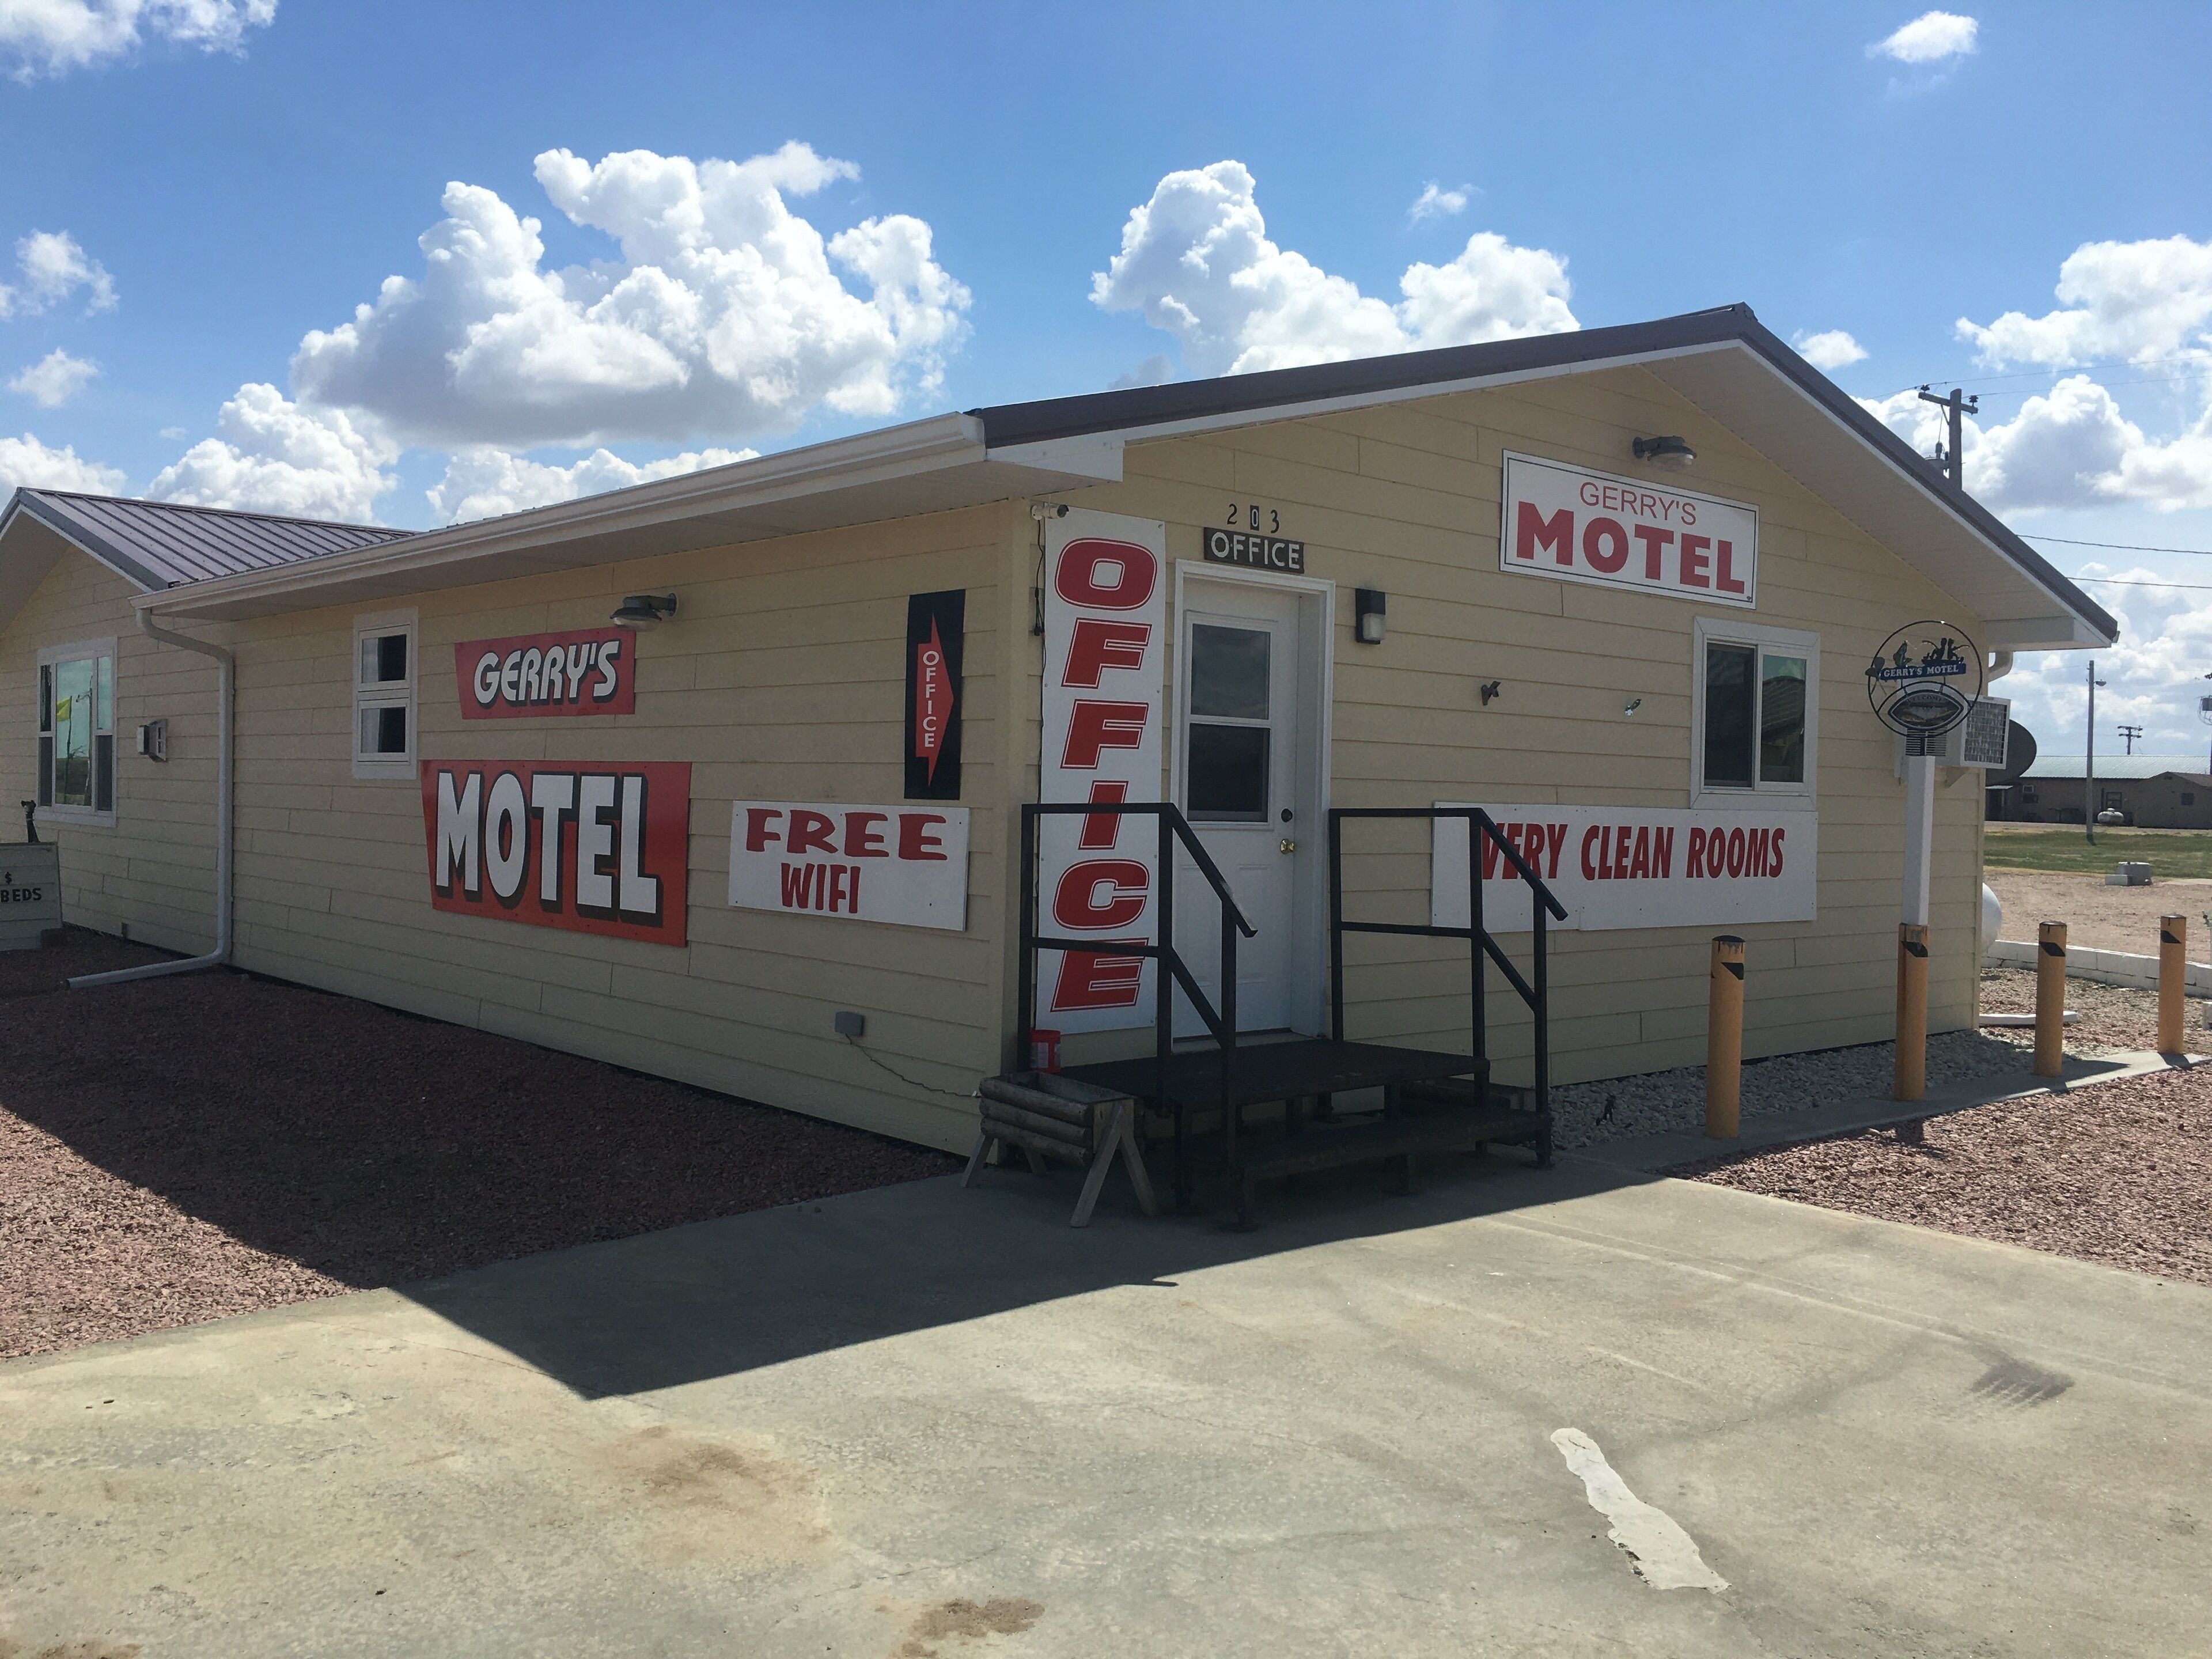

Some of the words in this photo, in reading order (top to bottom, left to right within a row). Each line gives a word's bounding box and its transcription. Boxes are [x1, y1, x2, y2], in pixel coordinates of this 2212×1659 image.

[1580, 482, 1697, 526] GERRY'S
[1211, 532, 1301, 570] OFFICE
[1517, 500, 1745, 594] MOTEL
[474, 640, 622, 707] GERRY'S
[1883, 668, 1922, 677] GERRY'S
[1927, 664, 1959, 674] MOTEL
[922, 650, 940, 748] OFFICE
[1050, 537, 1157, 1013] OFFICE
[435, 770, 662, 927] MOTEL
[745, 808, 948, 861] FREE
[1481, 823, 1569, 880] VERY
[1581, 824, 1675, 881] CLEAN
[1686, 826, 1785, 878] ROOMS
[1, 888, 42, 903] BEDS
[781, 862, 861, 914] WIFI
